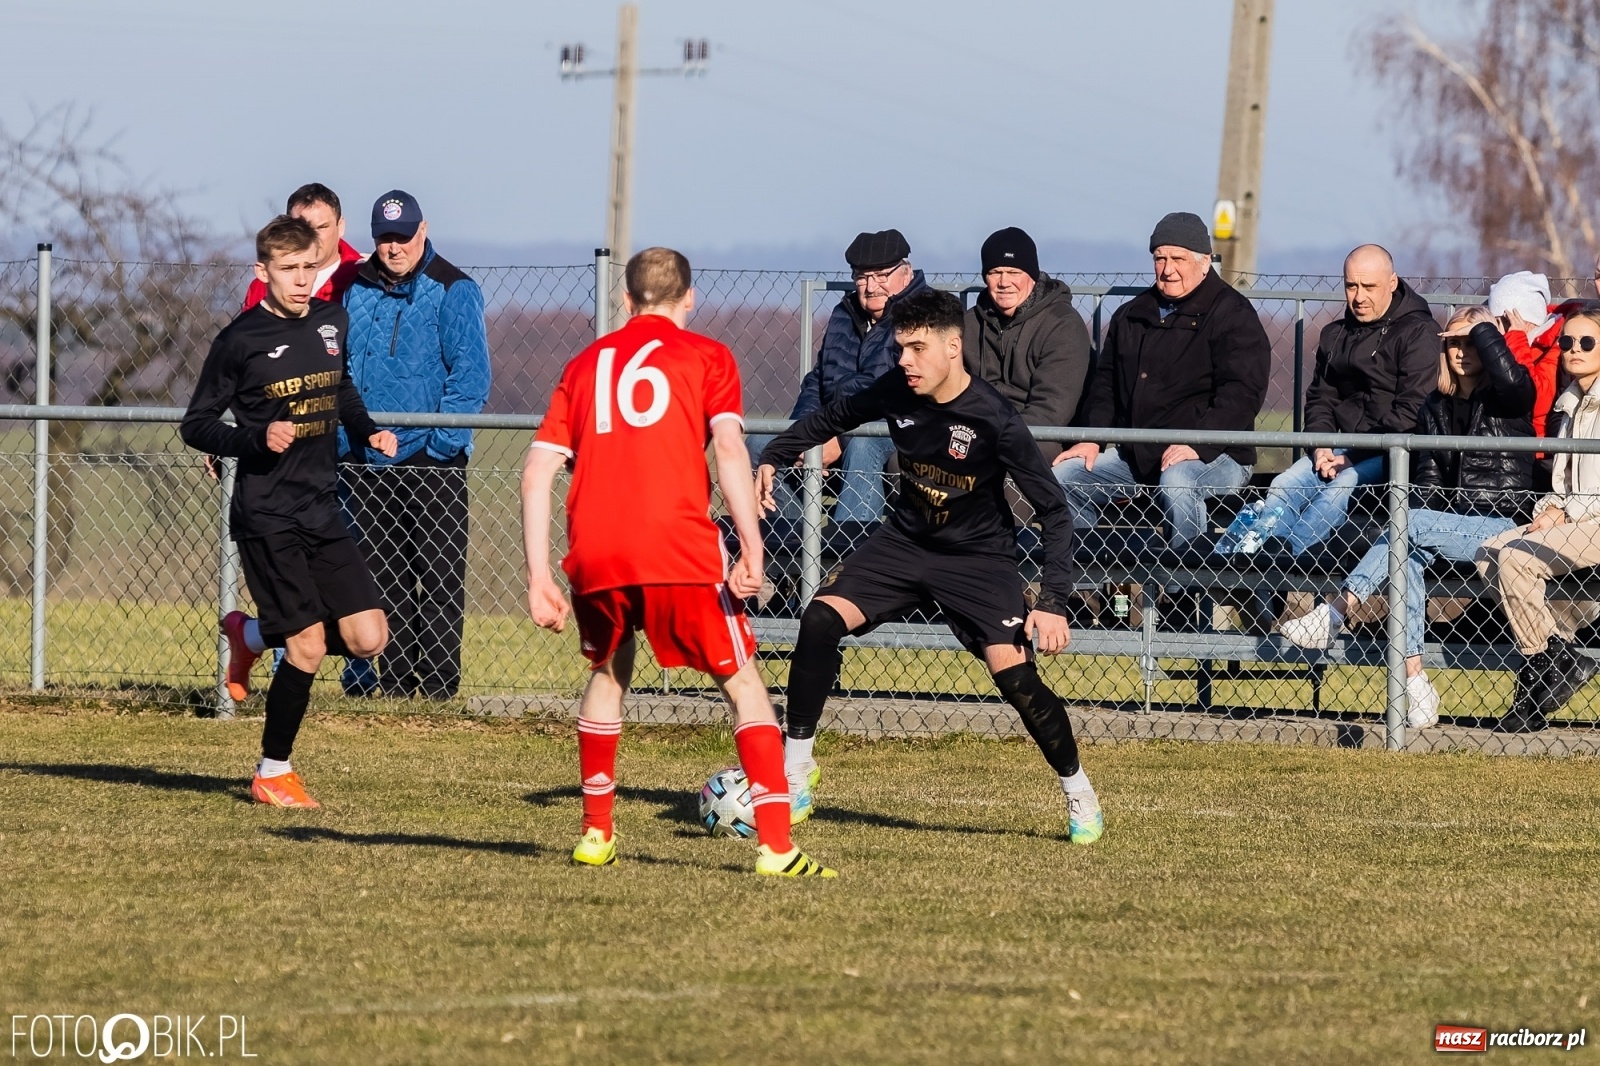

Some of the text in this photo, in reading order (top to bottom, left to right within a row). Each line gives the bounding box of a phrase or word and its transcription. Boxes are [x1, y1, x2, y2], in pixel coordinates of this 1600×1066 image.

[263, 377, 303, 400] SKLEP
[595, 338, 671, 434] 16
[951, 441, 967, 454] KS
[912, 462, 976, 492] SPORTOWY
[934, 510, 949, 525] 17
